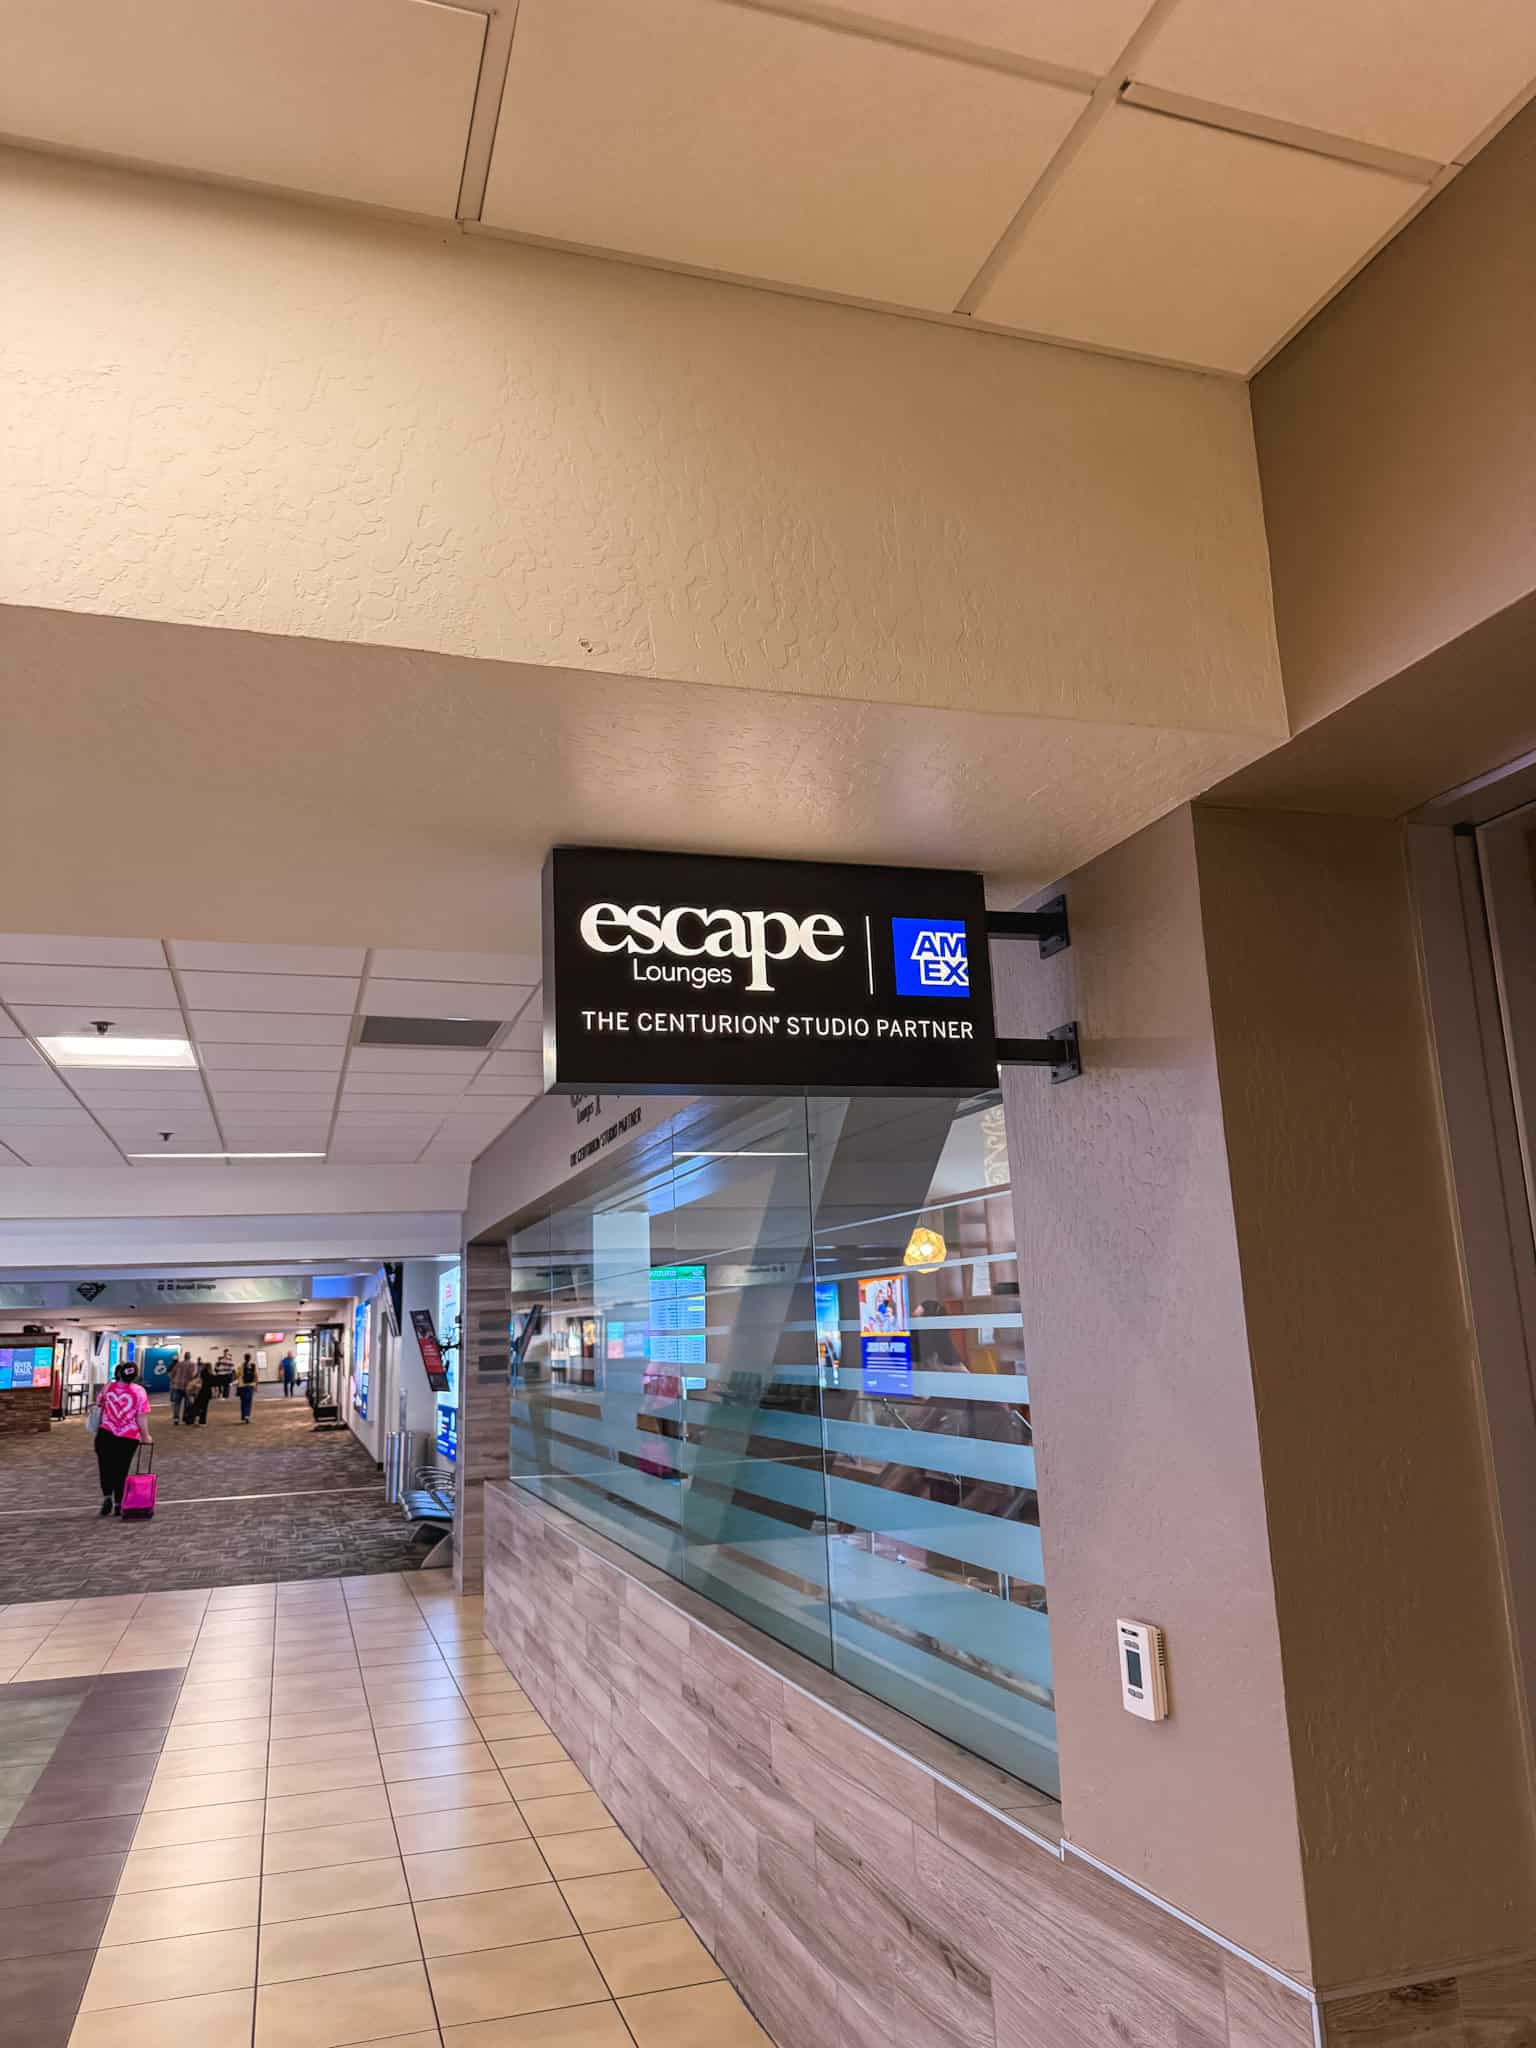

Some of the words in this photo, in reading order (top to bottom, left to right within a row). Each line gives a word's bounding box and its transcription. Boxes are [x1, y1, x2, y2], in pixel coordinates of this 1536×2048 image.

[580, 903, 845, 992] escape
[633, 958, 733, 989] Lounges
[581, 1011, 630, 1031] THE
[786, 1016, 870, 1037] STUDIO
[876, 1019, 974, 1040] PARTNER
